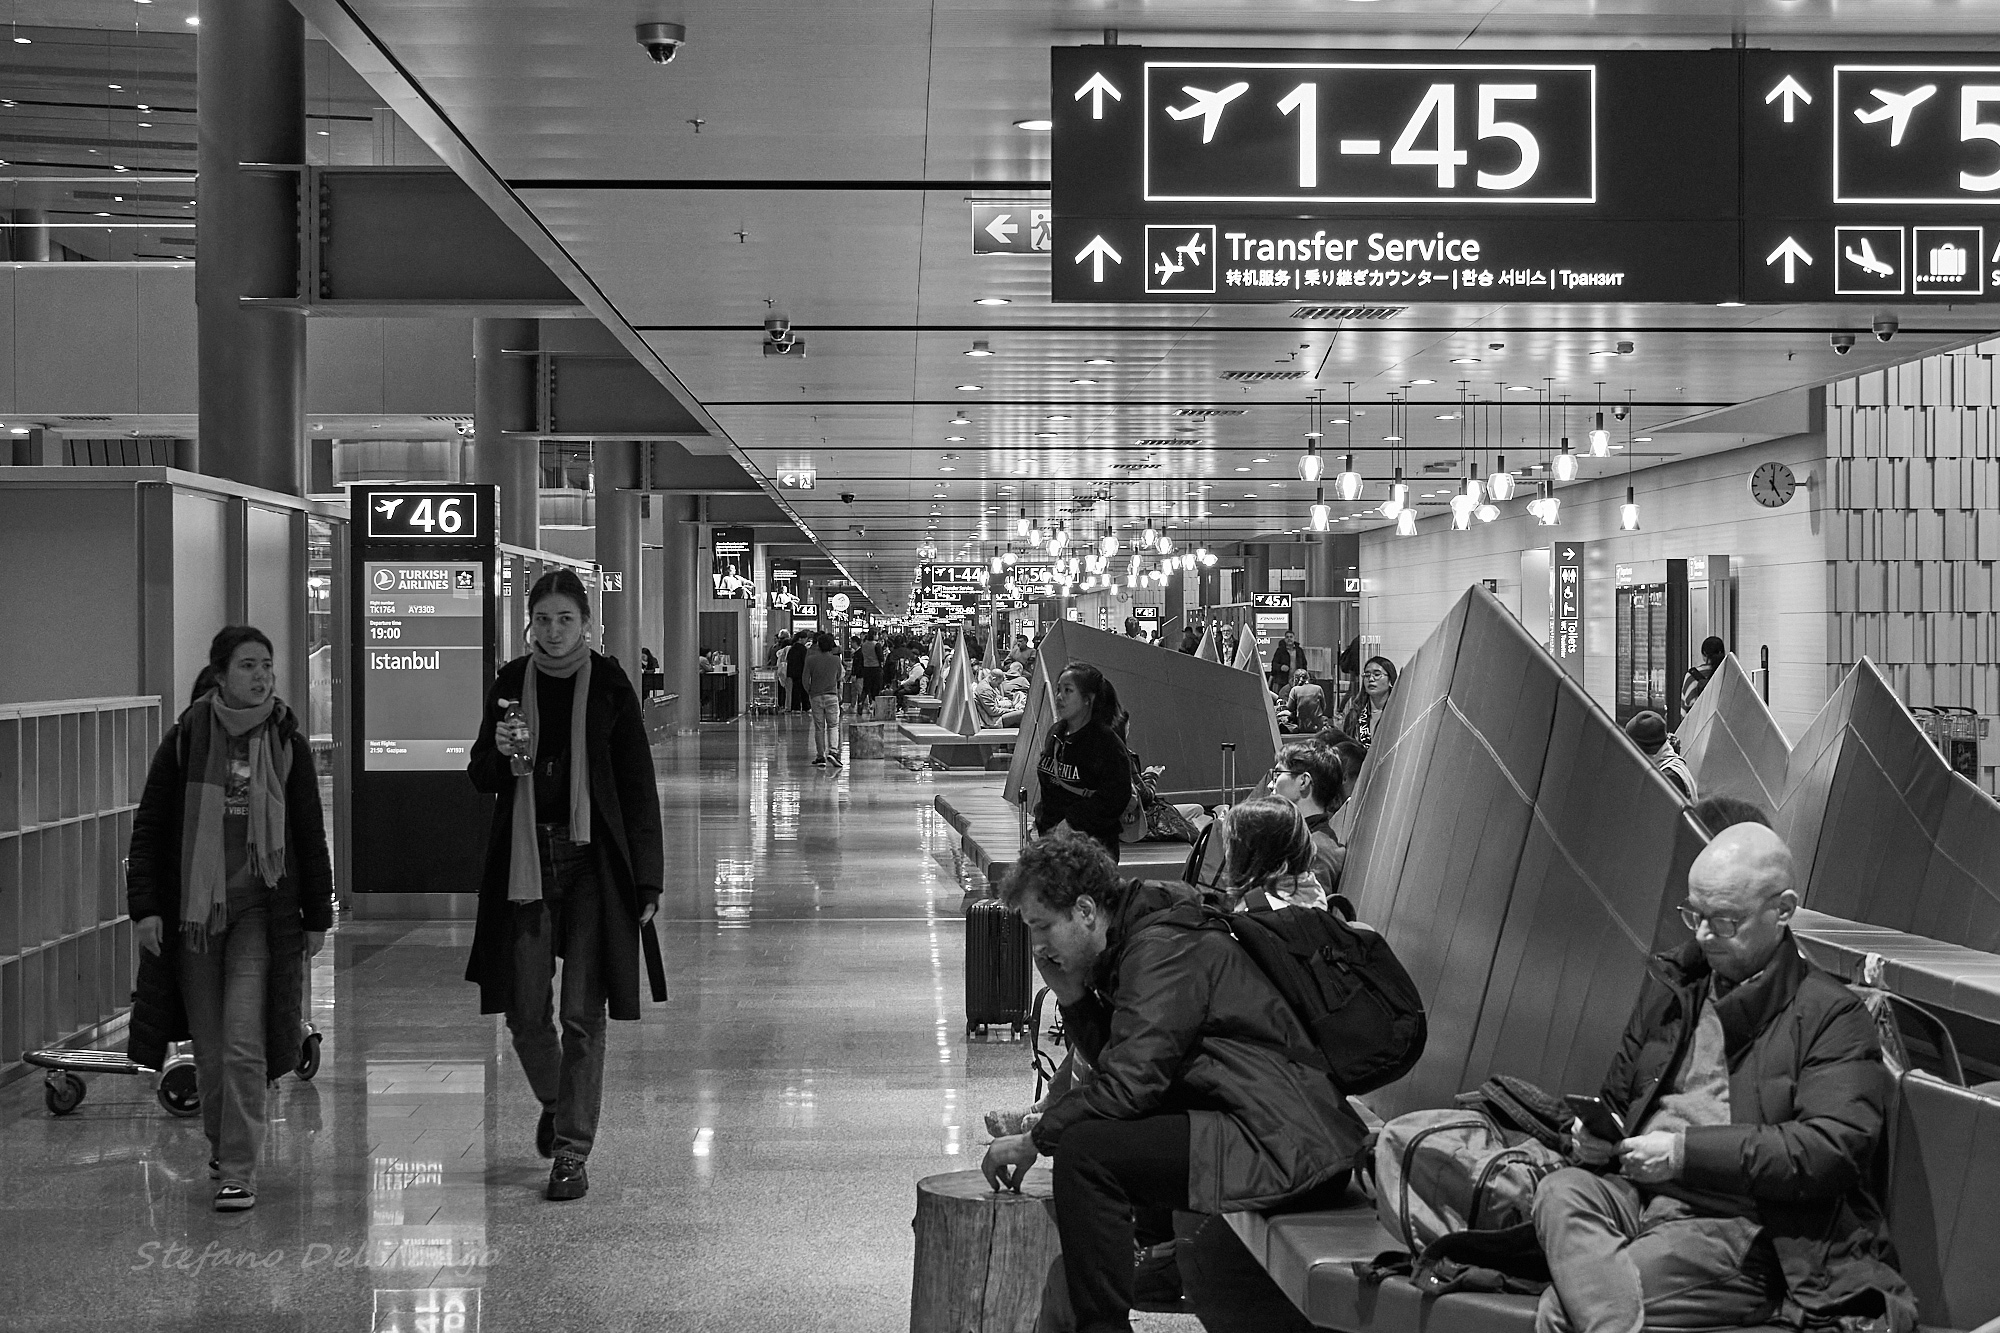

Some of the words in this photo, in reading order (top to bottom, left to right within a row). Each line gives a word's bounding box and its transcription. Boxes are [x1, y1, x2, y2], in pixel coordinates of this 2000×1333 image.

[1276, 82, 1540, 190] 1-45
[1225, 231, 1359, 262] Transfer
[1367, 231, 1481, 262] Service
[1225, 268, 1292, 287] 转机服务
[1304, 268, 1450, 287] 乗り継ぎカウンター
[1498, 269, 1547, 287] 서비스
[1559, 269, 1625, 290] Транзит
[409, 498, 462, 533] 46
[398, 569, 449, 580] TURKISH
[398, 580, 449, 590] AIRLINES
[370, 606, 396, 614] TK1764
[408, 605, 435, 614] AY3303
[370, 627, 401, 639] 19:00
[1568, 620, 1578, 654] Toilets
[371, 651, 440, 670] Istanbul
